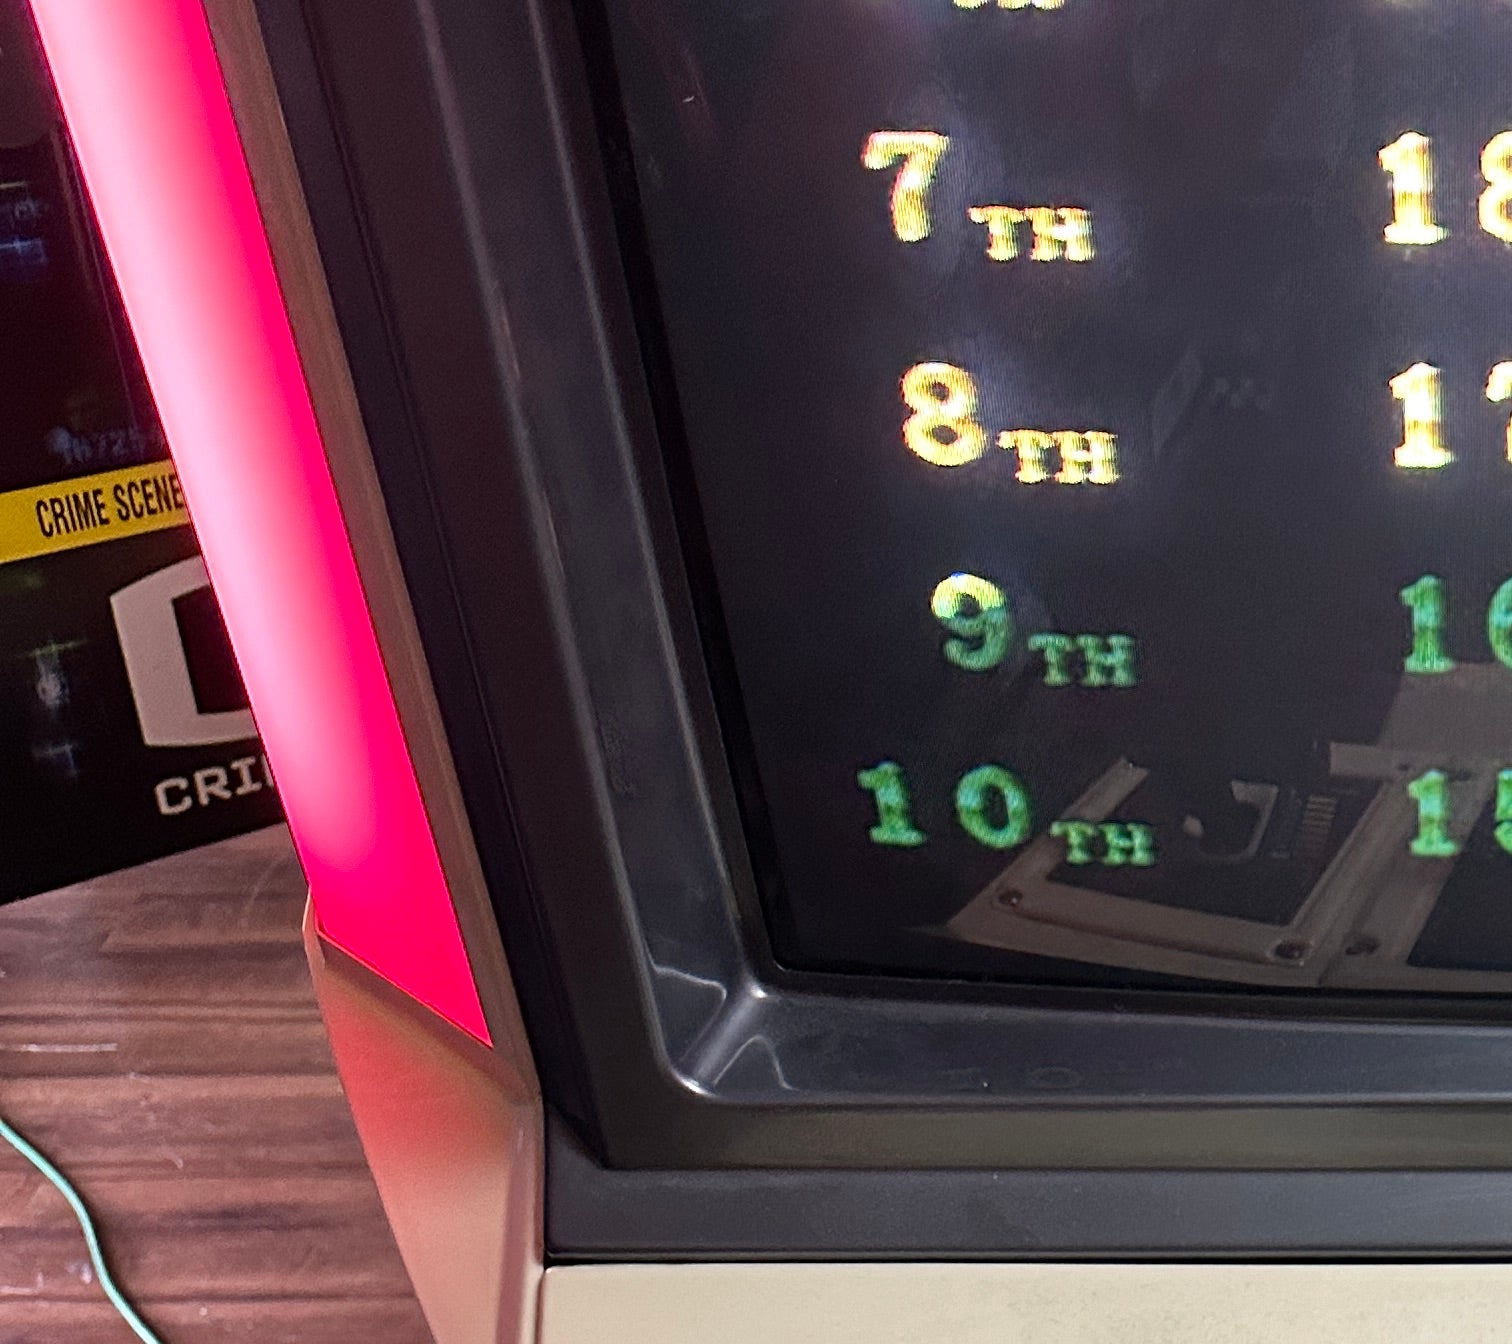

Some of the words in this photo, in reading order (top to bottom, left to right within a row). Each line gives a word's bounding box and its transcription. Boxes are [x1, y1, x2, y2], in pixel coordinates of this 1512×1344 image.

[36, 488, 110, 538] CRIME
[113, 474, 184, 520] SCENE
[155, 757, 274, 816] CRI
